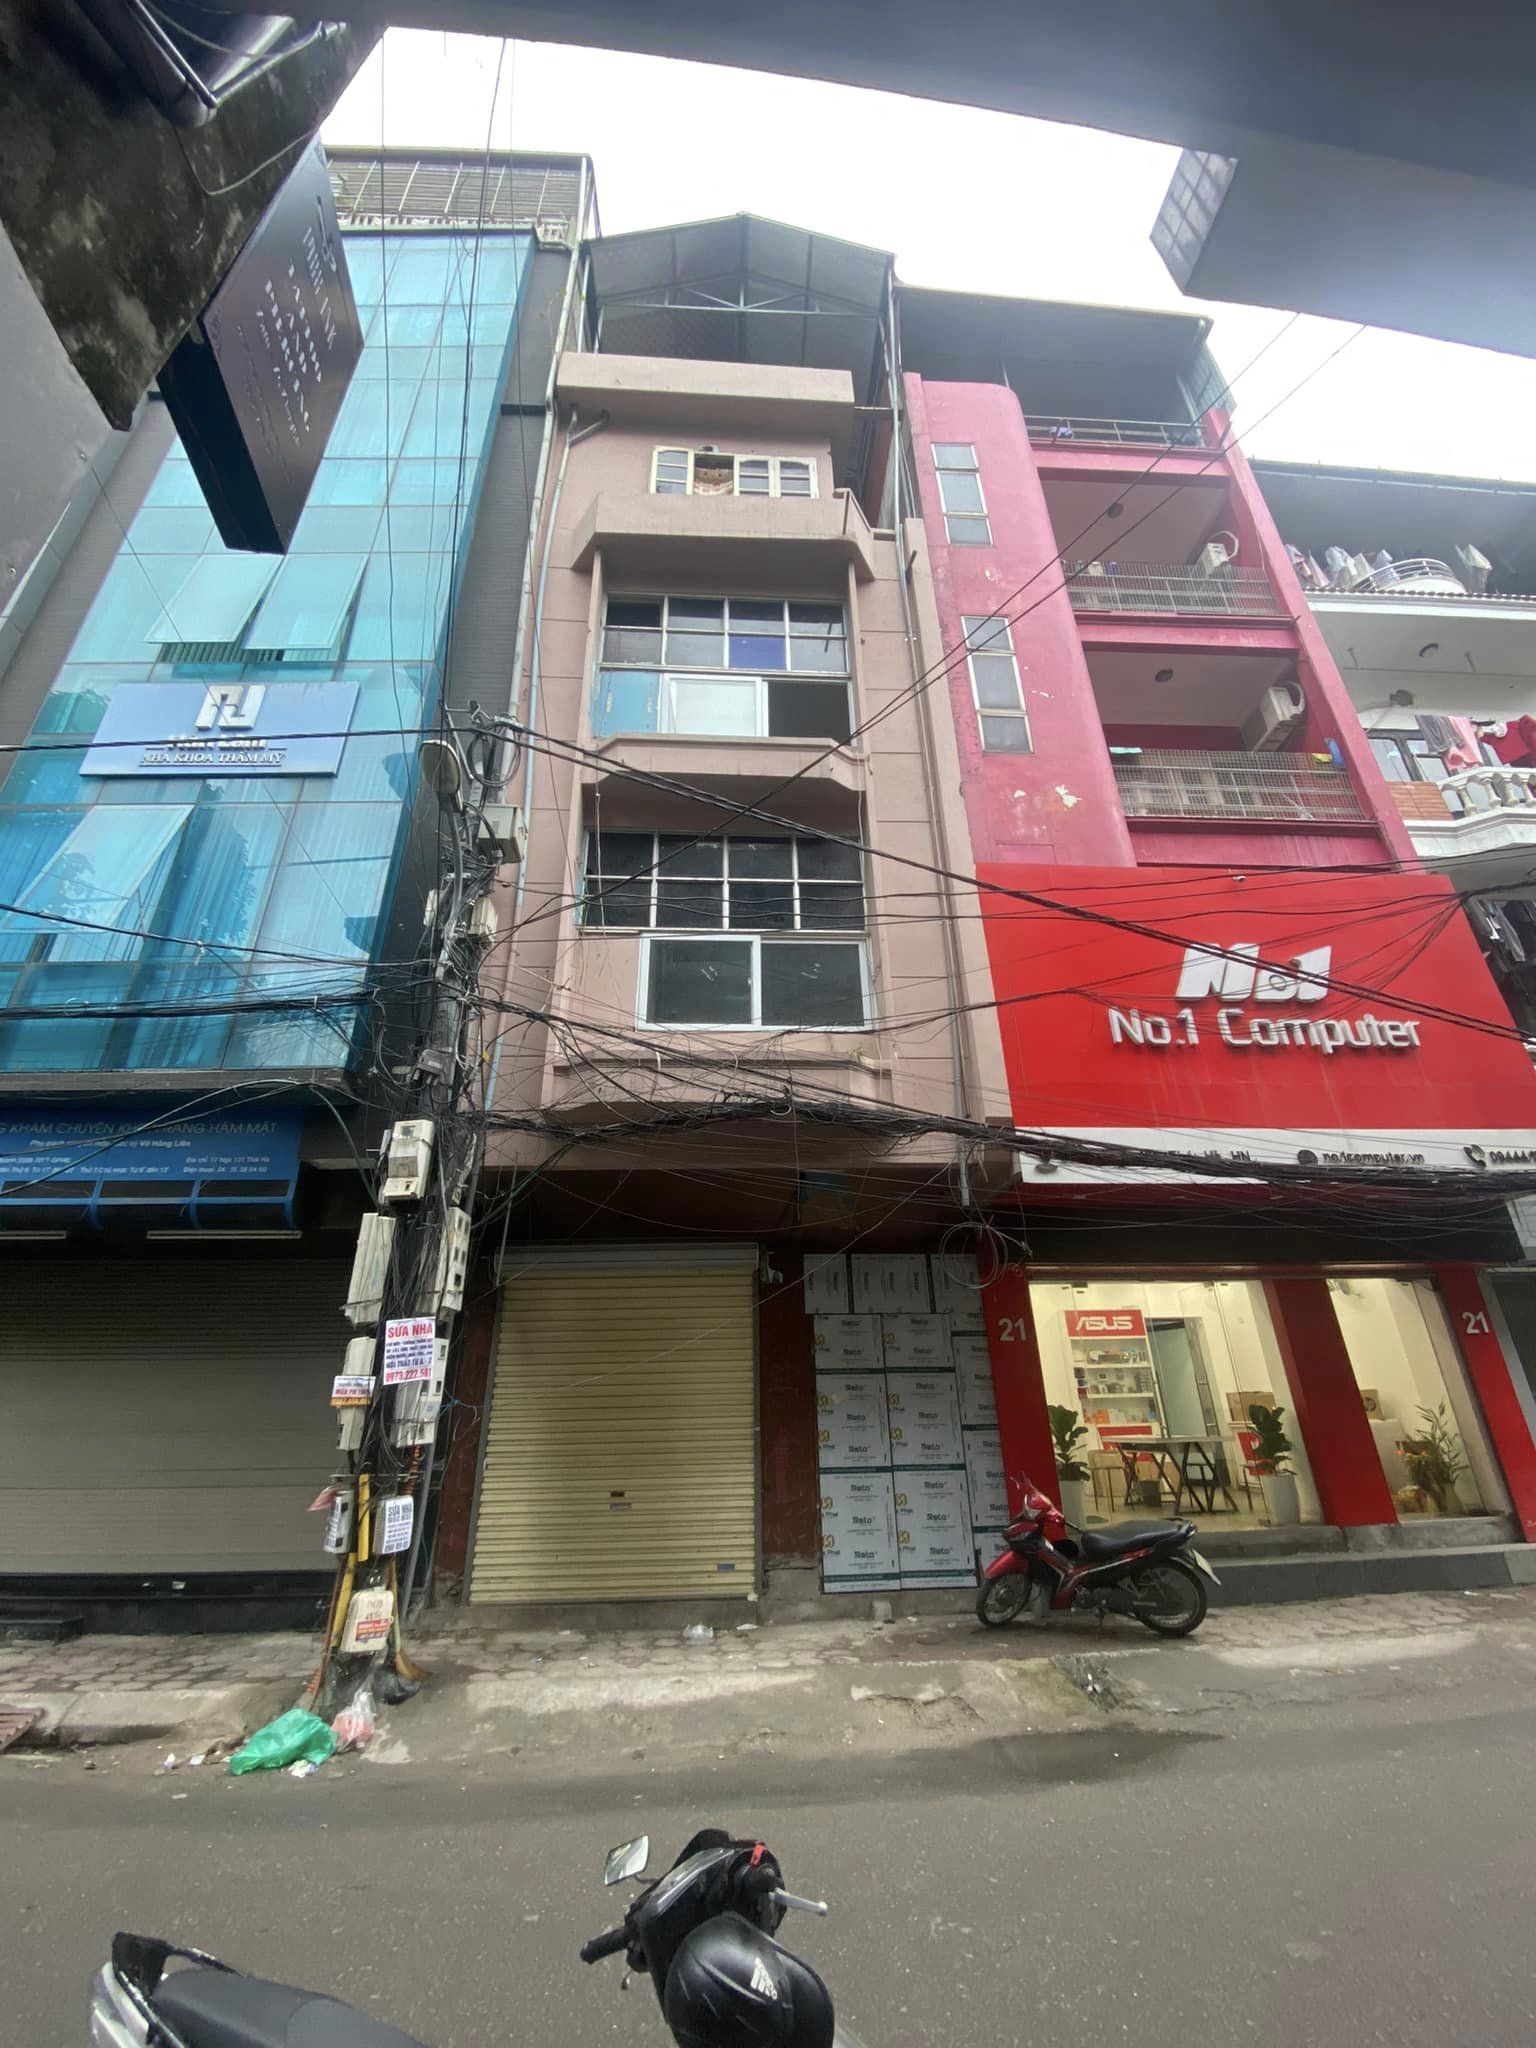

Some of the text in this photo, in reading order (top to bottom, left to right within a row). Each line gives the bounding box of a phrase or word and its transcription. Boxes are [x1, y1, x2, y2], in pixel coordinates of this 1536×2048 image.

[174, 752, 213, 763] KHOA
[1108, 1007, 1421, 1055] No.1 Computer
[1230, 1150, 1252, 1161] HN
[998, 1317, 1027, 1342] 21
[1075, 1315, 1134, 1332] ASUS
[1461, 1311, 1490, 1335] 21
